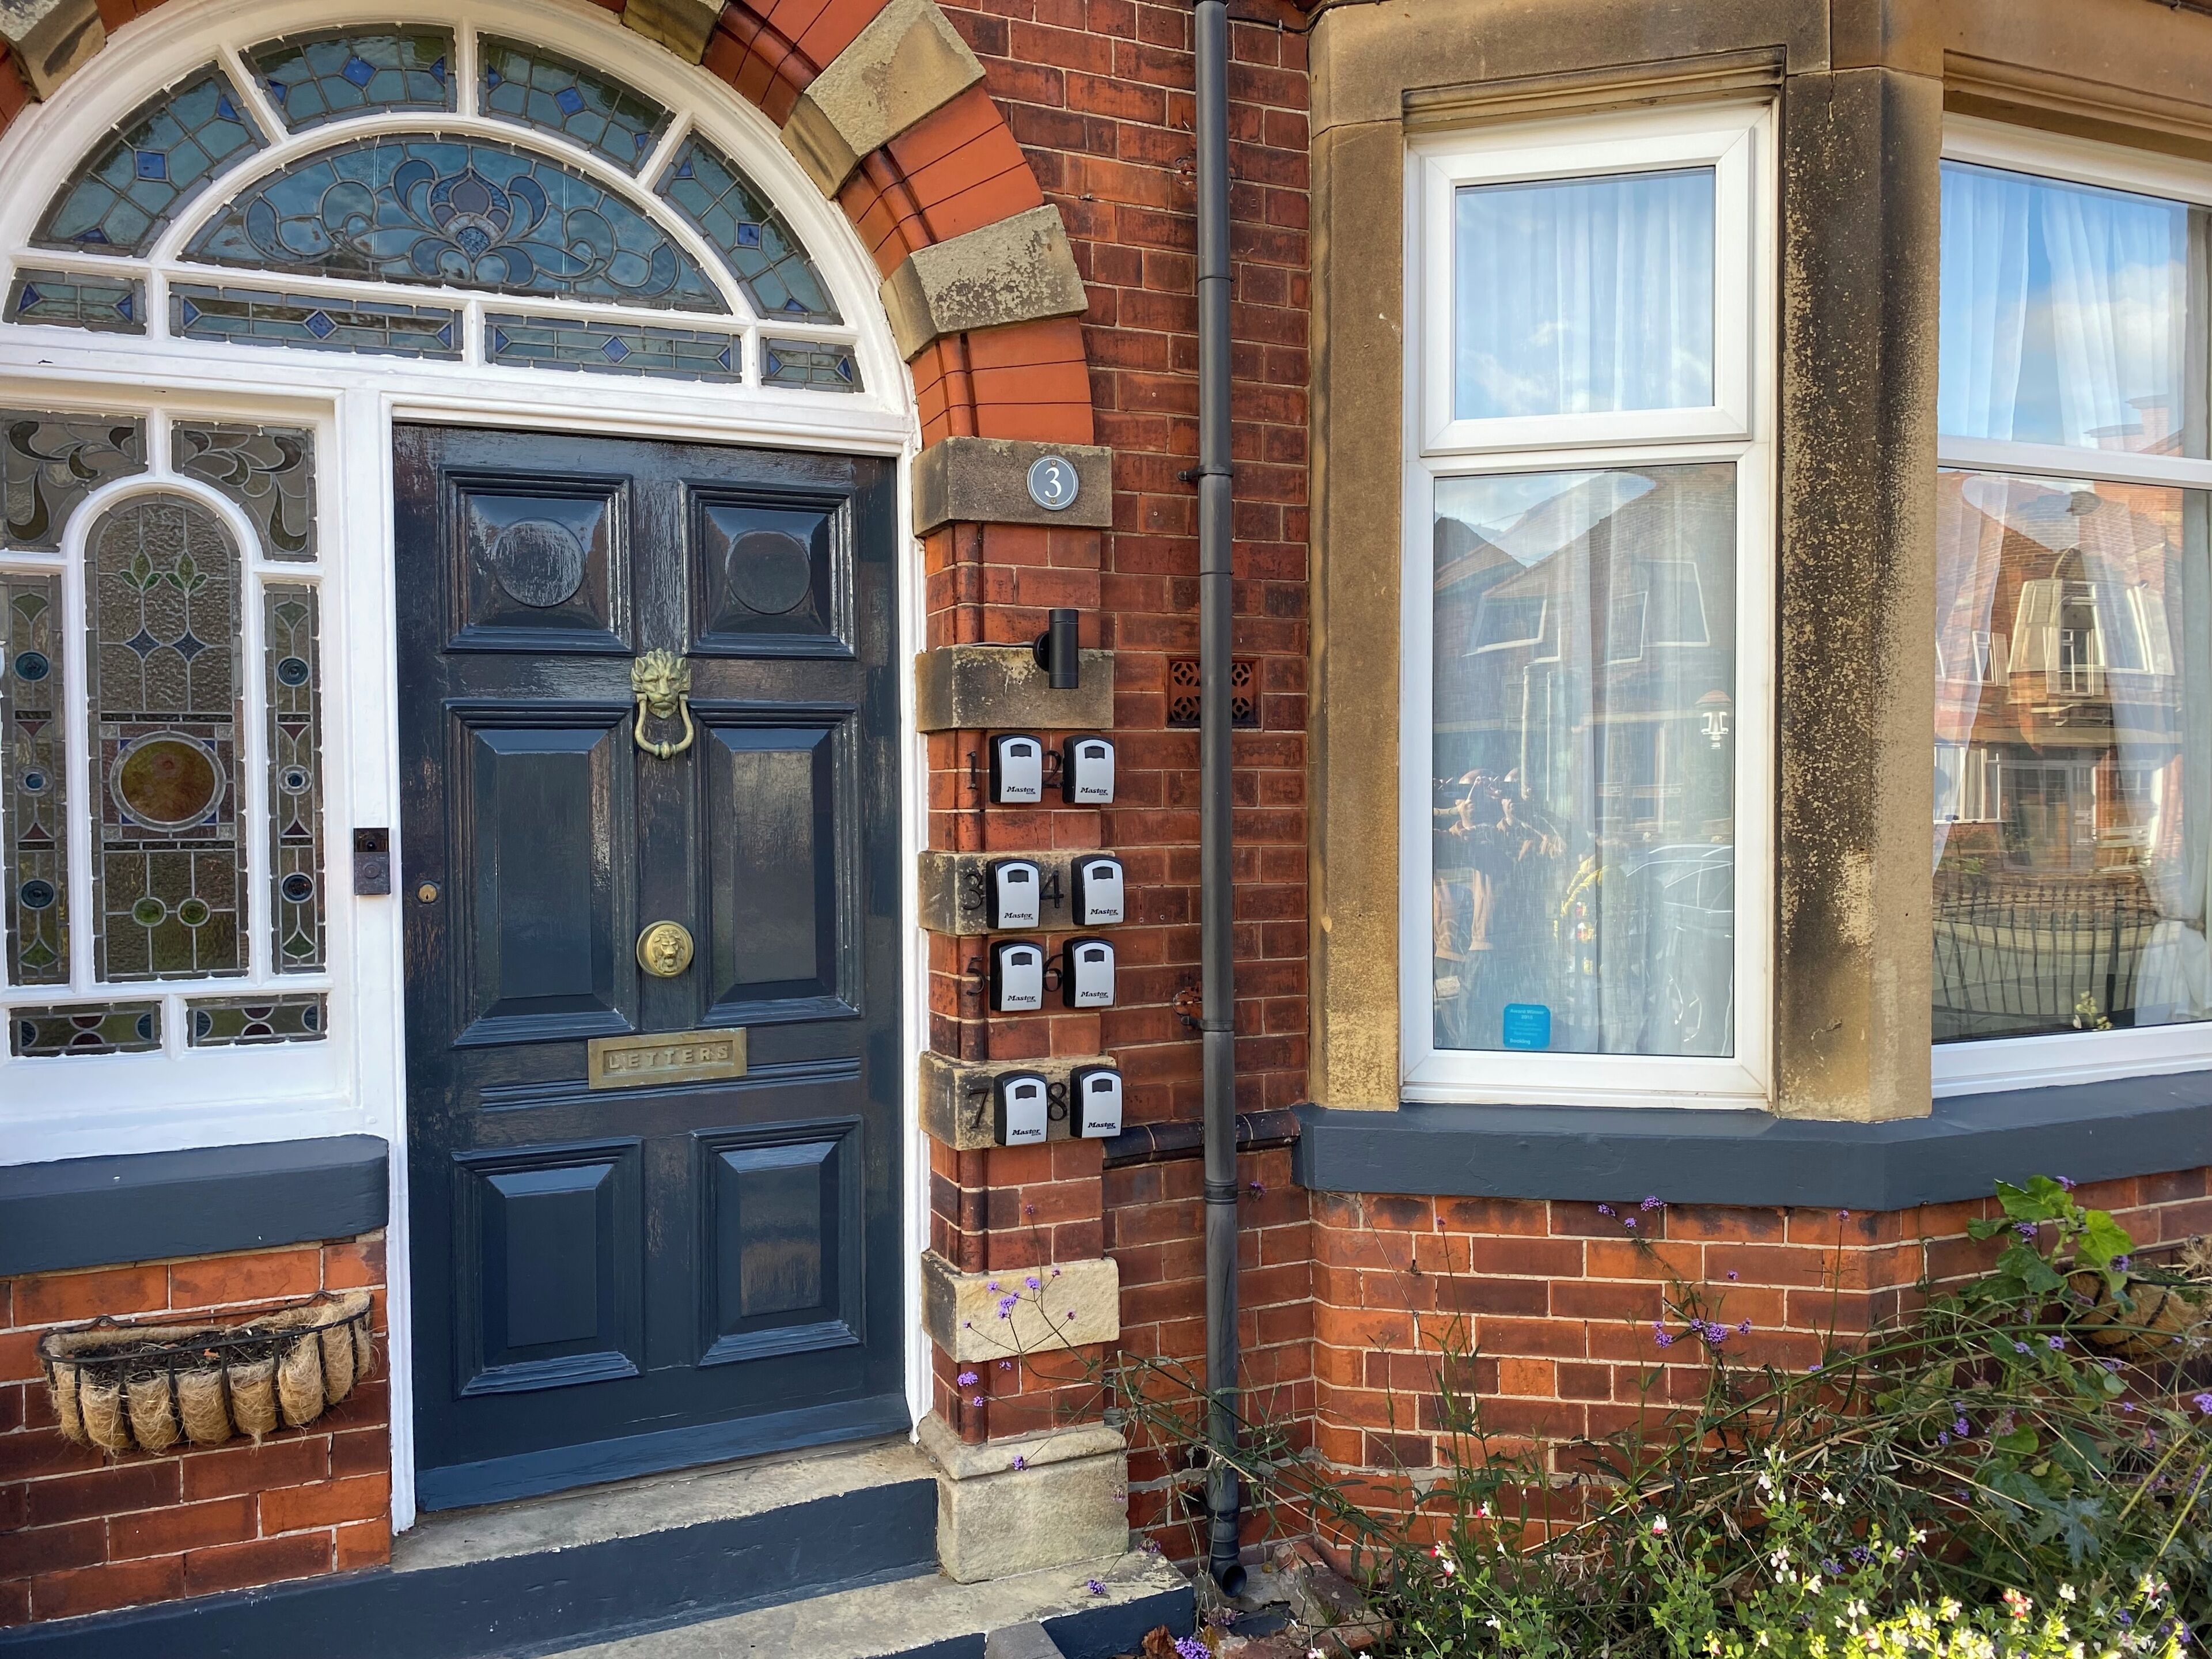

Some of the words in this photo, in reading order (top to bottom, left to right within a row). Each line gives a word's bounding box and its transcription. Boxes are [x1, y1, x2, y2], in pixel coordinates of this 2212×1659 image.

[1044, 467, 1062, 498] 3
[967, 751, 978, 789] 1
[1041, 750, 1063, 789] 2
[963, 872, 983, 910] 3
[1039, 870, 1065, 908] 4
[966, 956, 986, 997] 5
[1042, 953, 1064, 992] 6
[608, 1046, 729, 1069] LETTERS
[968, 1088, 990, 1129] 7
[1047, 1082, 1067, 1121] 8
